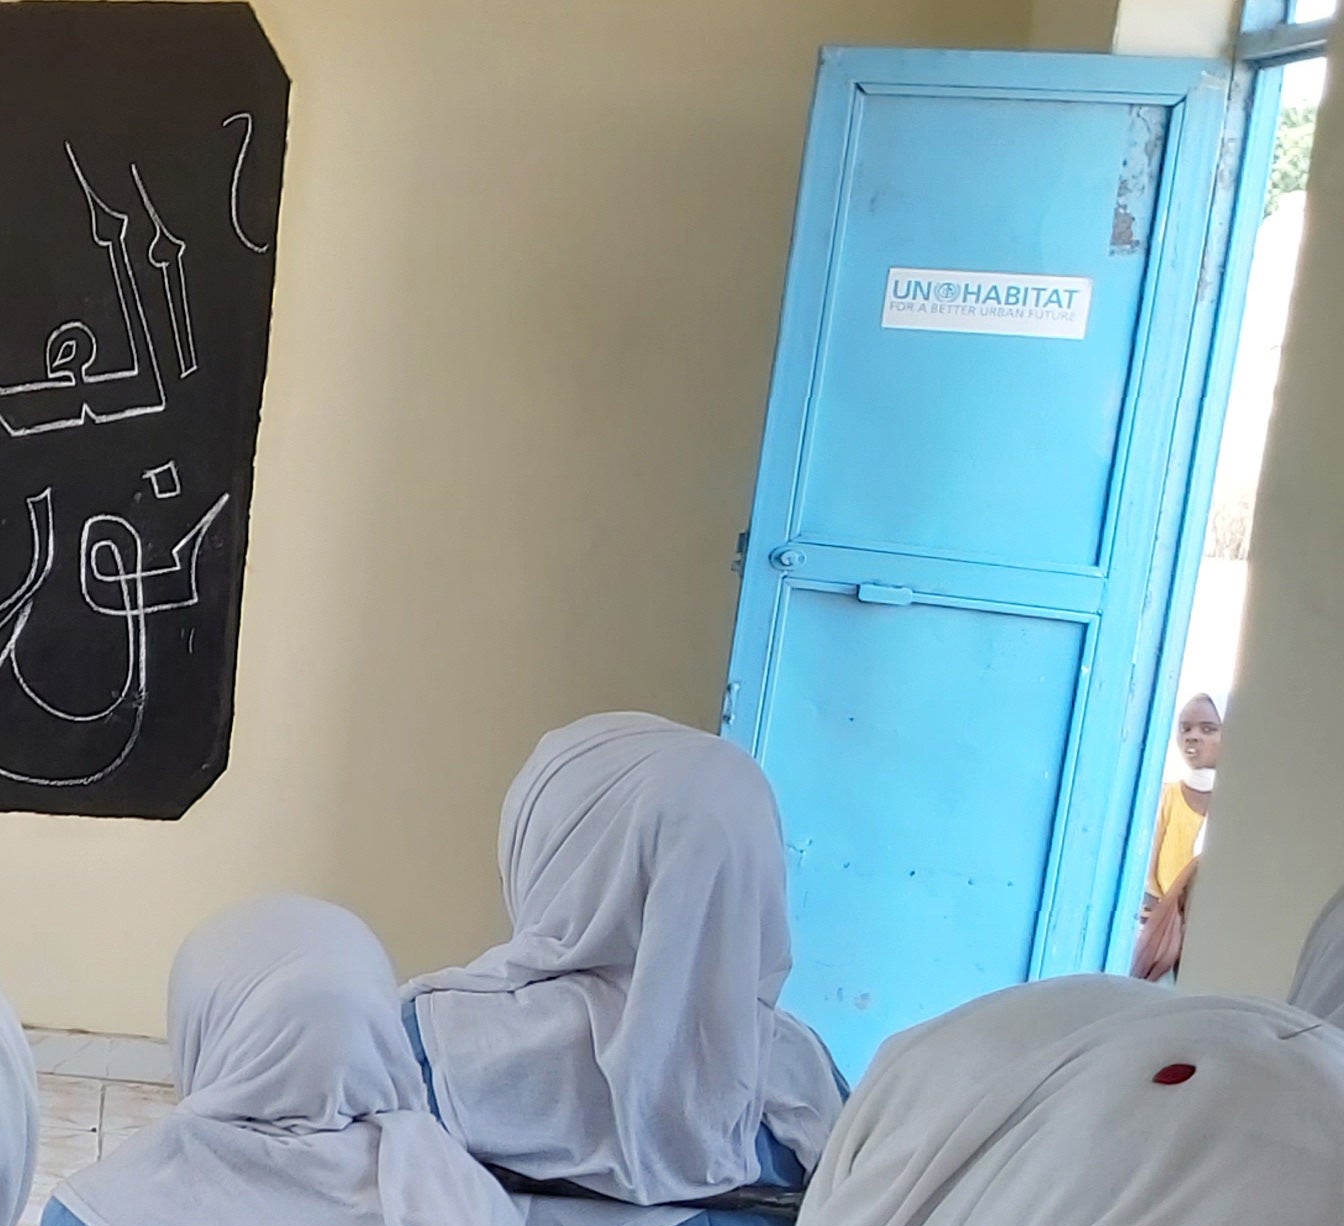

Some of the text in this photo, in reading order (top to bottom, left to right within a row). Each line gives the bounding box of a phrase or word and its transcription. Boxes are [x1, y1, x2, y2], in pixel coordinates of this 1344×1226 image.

[892, 279, 1080, 310] UN HABITAT
[888, 301, 1077, 323] FOR A BETTER URBAN FUTURE
